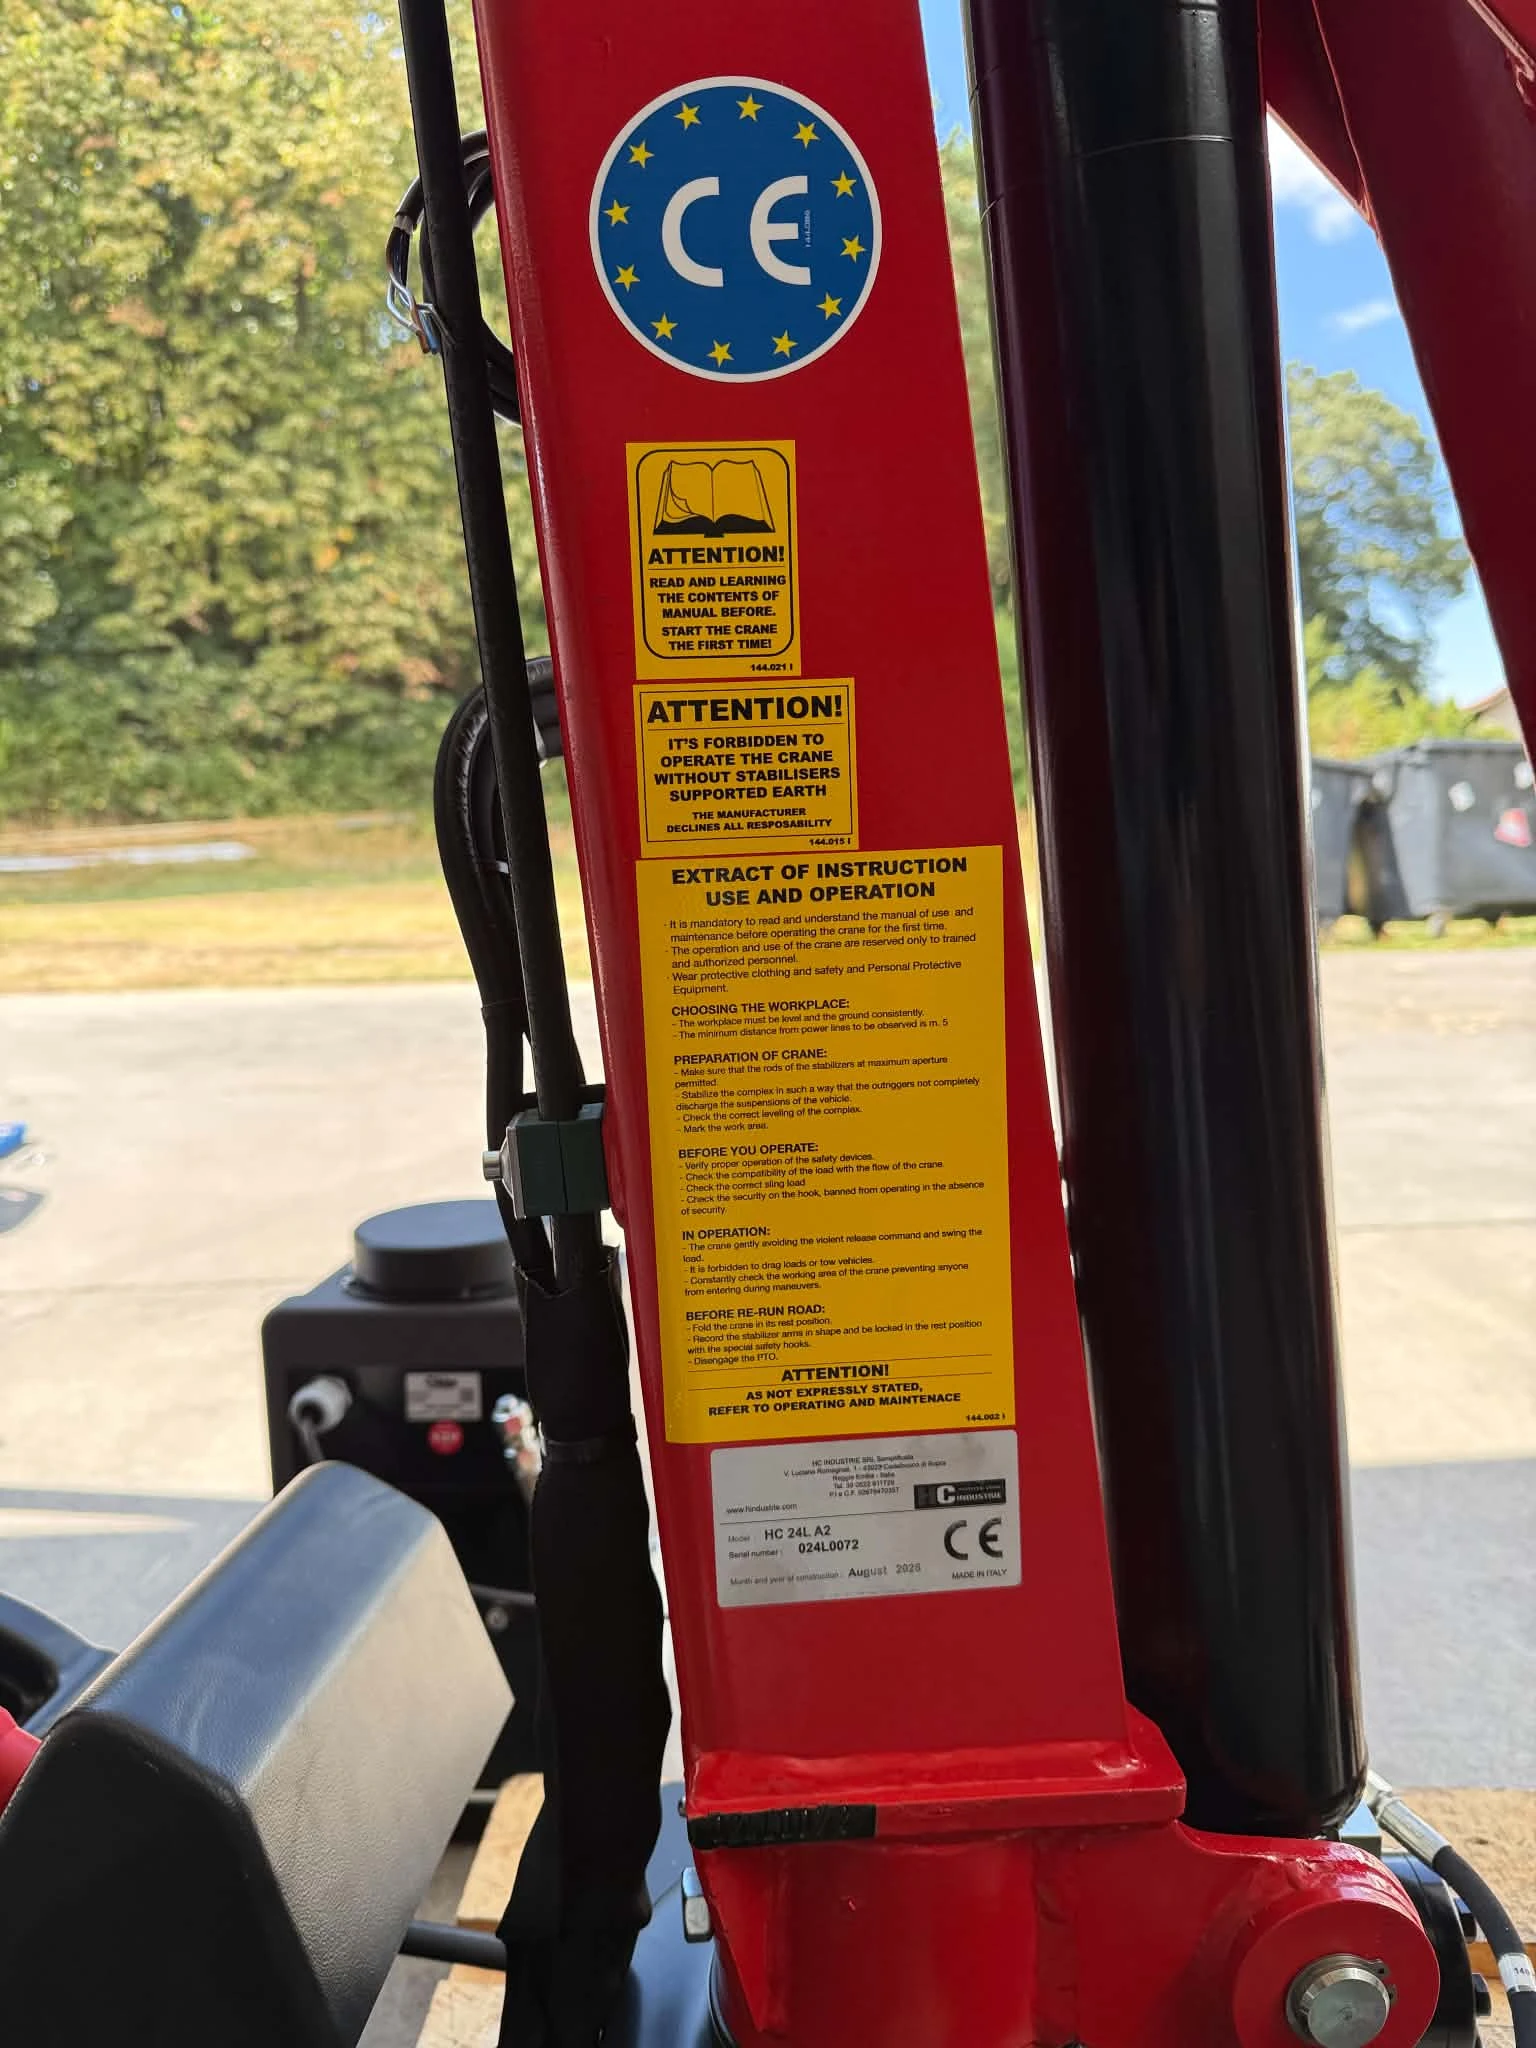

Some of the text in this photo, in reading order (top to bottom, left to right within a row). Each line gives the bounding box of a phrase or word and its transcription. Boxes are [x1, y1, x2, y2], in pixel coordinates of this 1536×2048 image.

[662, 175, 811, 287] CE
[648, 546, 784, 564] ATTENTION!
[649, 575, 786, 587] READ AND LEARNING
[657, 590, 779, 603] THE CONTENTS OF
[662, 606, 776, 618] MANUAL BEFORE.
[661, 624, 777, 636] START THE CRANE
[668, 640, 694, 650] THE
[697, 639, 733, 649] FIRST
[750, 663, 786, 671] 144.021
[647, 696, 842, 722] ATTENTION!
[668, 733, 824, 750] IT'S FORBIDDEN TO
[660, 750, 832, 767] OPERATE THE CRANE
[654, 767, 840, 784] WITHOUT STABILISERS
[669, 784, 826, 801] SUPPORTED EARTH
[692, 808, 806, 819] THE MANUFACTURER
[666, 819, 832, 832] DECLINES ALL RESPOSABILITY
[809, 837, 845, 845] 144.015
[671, 858, 966, 884] EXTRACT OF INSTRUCTION
[706, 882, 934, 906] USE AND OPERATION
[669, 920, 676, 928] It
[679, 919, 687, 928] is
[690, 919, 743, 928] mandatory
[745, 917, 756, 925] to
[758, 915, 780, 924] read
[782, 915, 801, 924] and
[804, 912, 859, 922] understand
[862, 911, 878, 920] the
[880, 909, 916, 919] manual
[919, 908, 928, 918] of
[954, 907, 973, 916] and
[670, 932, 734, 942] maintenance
[736, 930, 768, 939] before
[770, 928, 816, 938] operating
[819, 927, 835, 935] the
[867, 924, 881, 933] for
[883, 924, 900, 932] the
[902, 922, 920, 931] first
[670, 946, 690, 955] The
[691, 944, 739, 955] operation
[741, 943, 760, 952] and
[763, 943, 780, 951] use
[783, 941, 793, 950] of
[795, 941, 812, 949] the
[862, 936, 904, 946] reserved
[906, 935, 927, 945] only
[942, 933, 976, 942] trained
[671, 959, 690, 968] and
[693, 957, 744, 967] authorized
[671, 961, 961, 981] Wear protective clothing and safety and Personal Protective
[672, 984, 728, 995] Equipment.
[671, 998, 849, 1016] CHOOSING THE WORKPLACE:
[673, 1048, 826, 1064] PREPARATION OF CRANE:
[678, 1142, 818, 1158] BEFORE YOU OPERATE:
[682, 1226, 770, 1240] IN OPERATION:
[689, 1265, 695, 1273] It
[707, 1264, 748, 1272] forbidden
[761, 1262, 781, 1270] drag
[783, 1260, 807, 1268] loads
[684, 1288, 704, 1296] from
[706, 1286, 741, 1294] entering
[742, 1285, 770, 1293] during
[685, 1304, 824, 1320] BEFORE RE-RUN ROAD:
[692, 1323, 711, 1331] Fold
[755, 1320, 763, 1328] in
[781, 1364, 888, 1380] ATTENTION!
[746, 1382, 922, 1400] AS NOT EXPRESSLY STATED,
[708, 1393, 960, 1415] REFER TO OPERATING AND MAINTENACE
[764, 1528, 783, 1540] HC
[787, 1527, 810, 1538] 24L
[814, 1524, 830, 1536] A2
[943, 1517, 1003, 1560] CE
[798, 1539, 858, 1553] 024L0072
[848, 1566, 886, 1577] August
[951, 1571, 974, 1579] MADE
[986, 1568, 1007, 1576] ITALY
